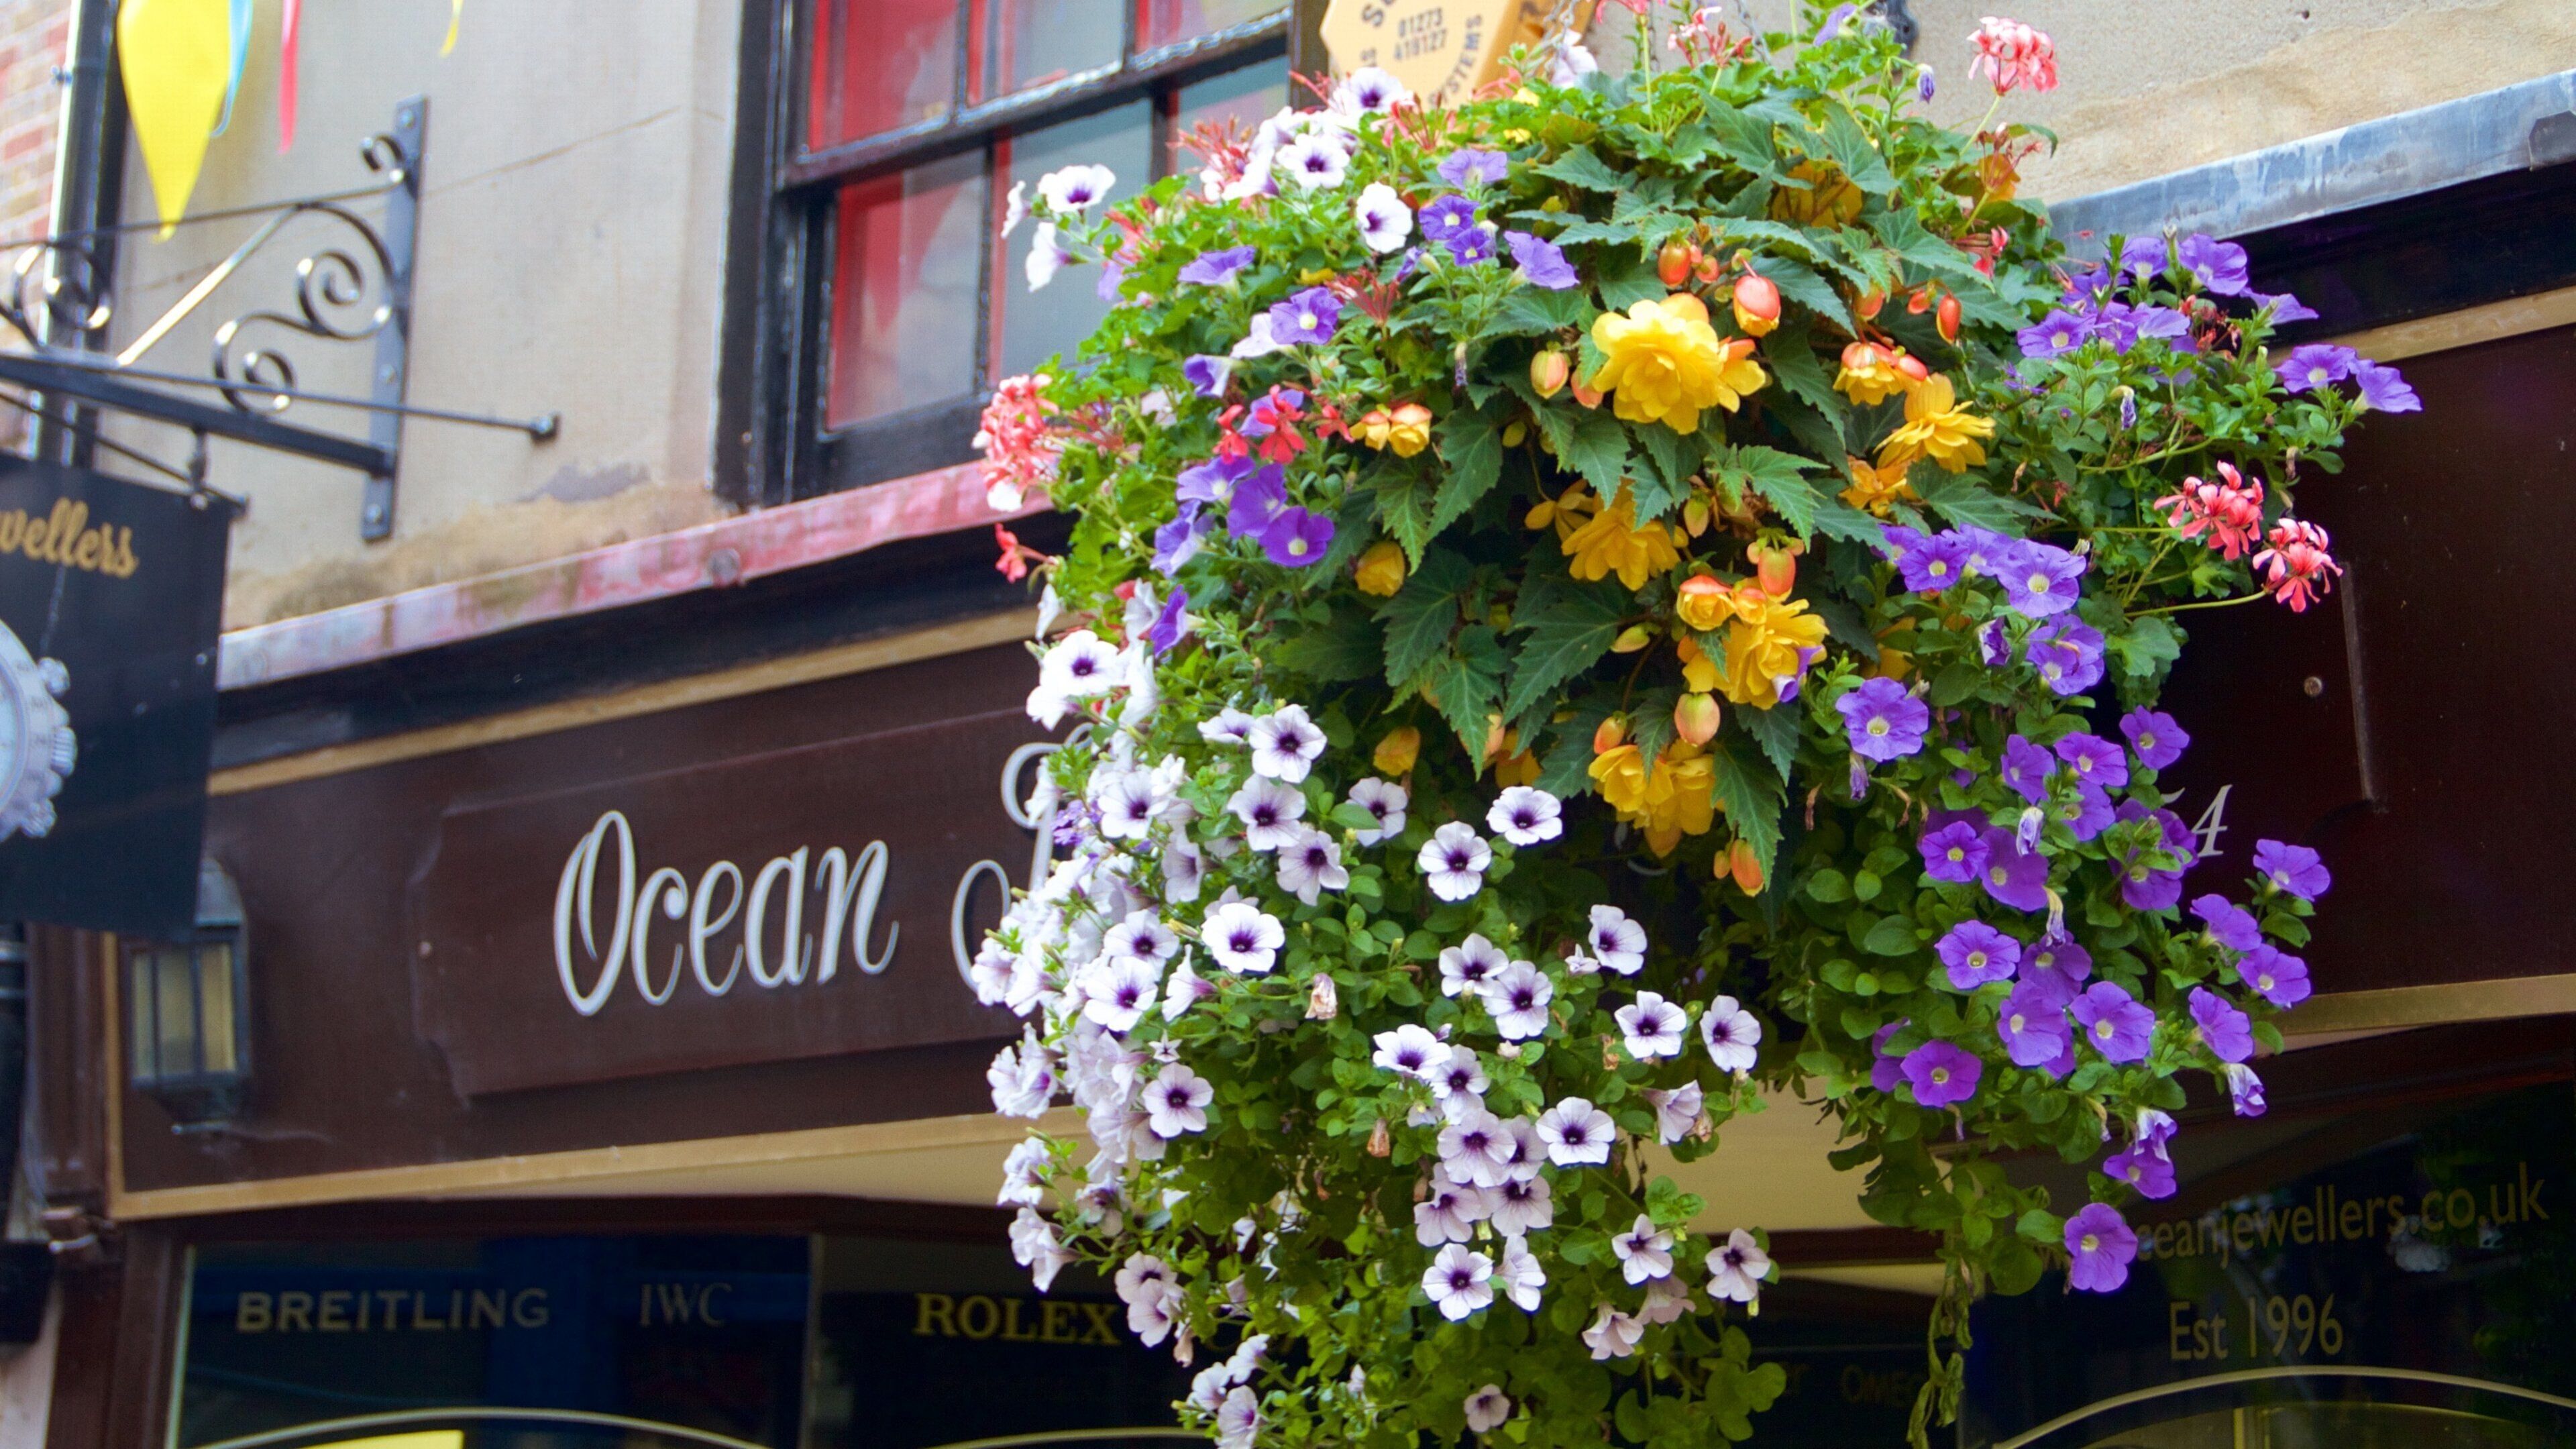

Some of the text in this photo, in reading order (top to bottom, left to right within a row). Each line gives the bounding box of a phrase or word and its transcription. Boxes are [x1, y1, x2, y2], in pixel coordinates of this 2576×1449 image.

[1398, 7, 1443, 38] 01273
[2161, 784, 2233, 851] 4
[553, 810, 900, 1016] Ocean
[2136, 1161, 2552, 1268] ceanjewellers.co.uk
[236, 1288, 549, 1333] BREITLING
[638, 1282, 733, 1328] IWC
[912, 1292, 1122, 1346] ROLEX
[2169, 1293, 2345, 1362] Est 1996
